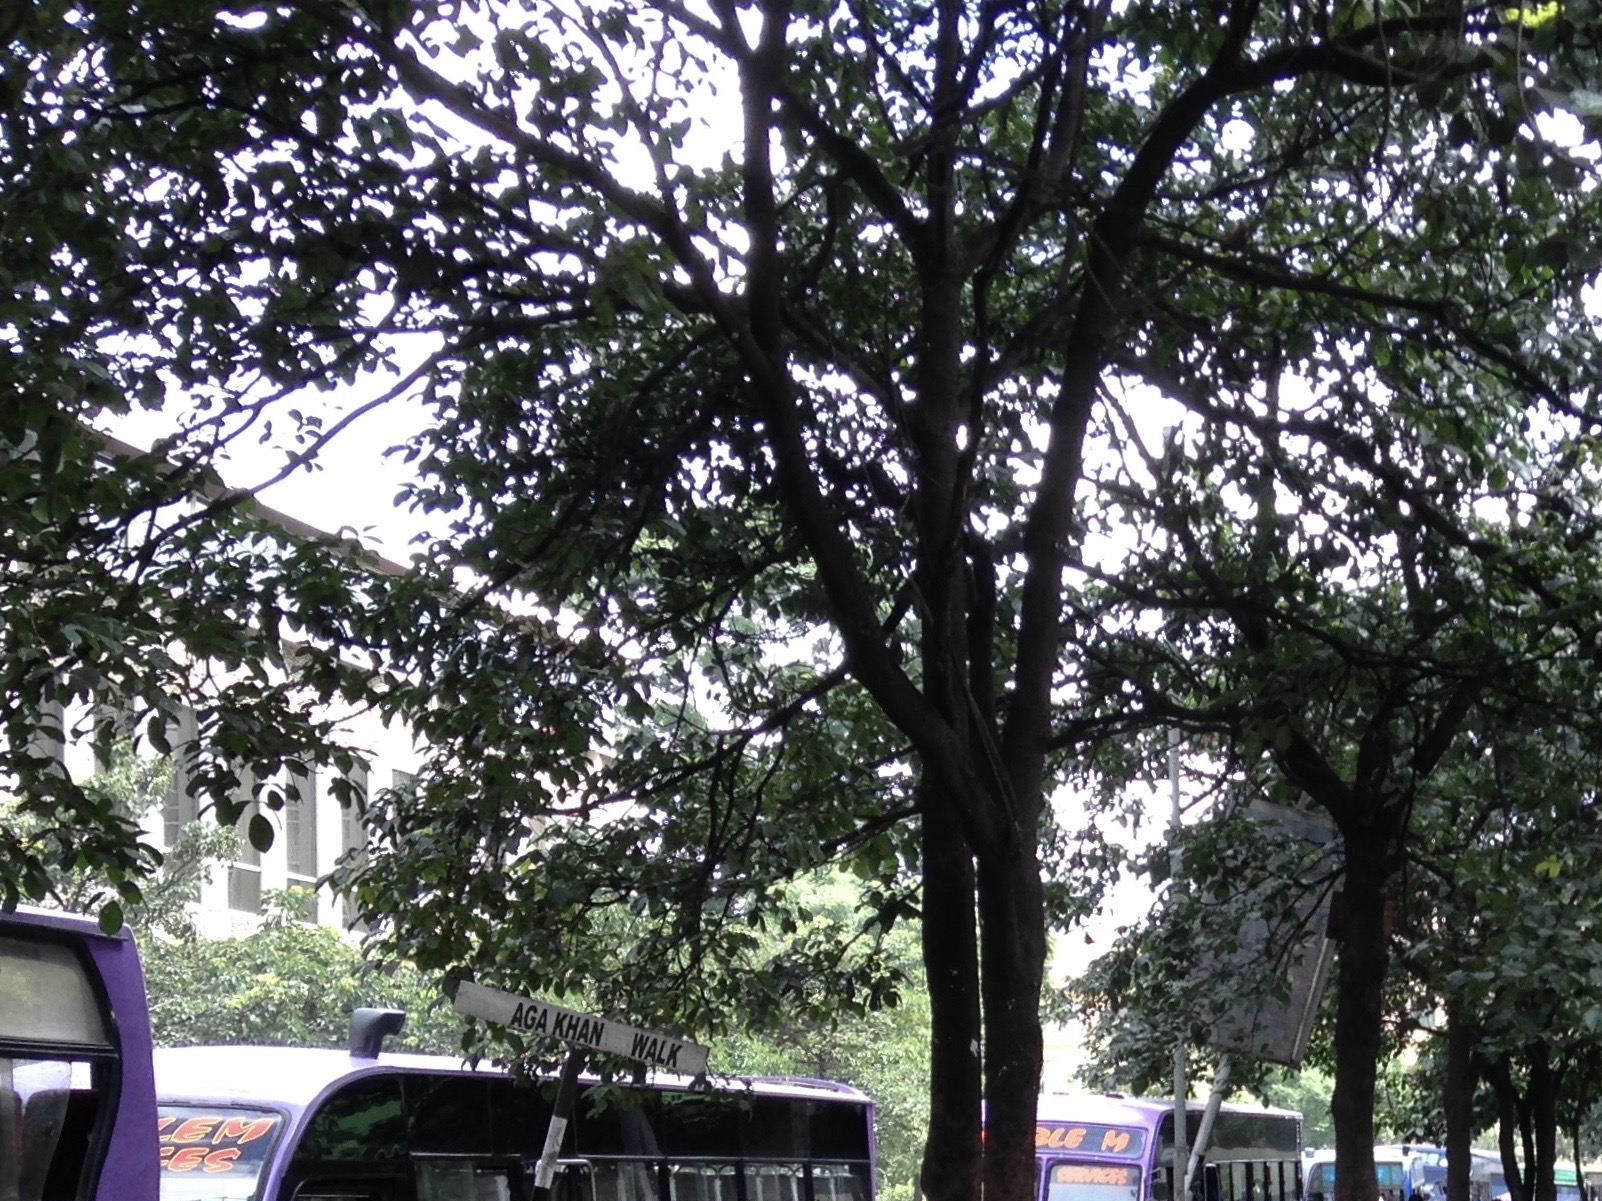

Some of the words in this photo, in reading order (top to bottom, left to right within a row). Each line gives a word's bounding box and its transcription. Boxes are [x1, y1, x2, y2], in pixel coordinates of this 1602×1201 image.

[509, 1002, 548, 1033] AGA
[552, 1011, 606, 1047] KHAN
[630, 1032, 683, 1068] WALK
[1101, 1130, 1130, 1153] M
